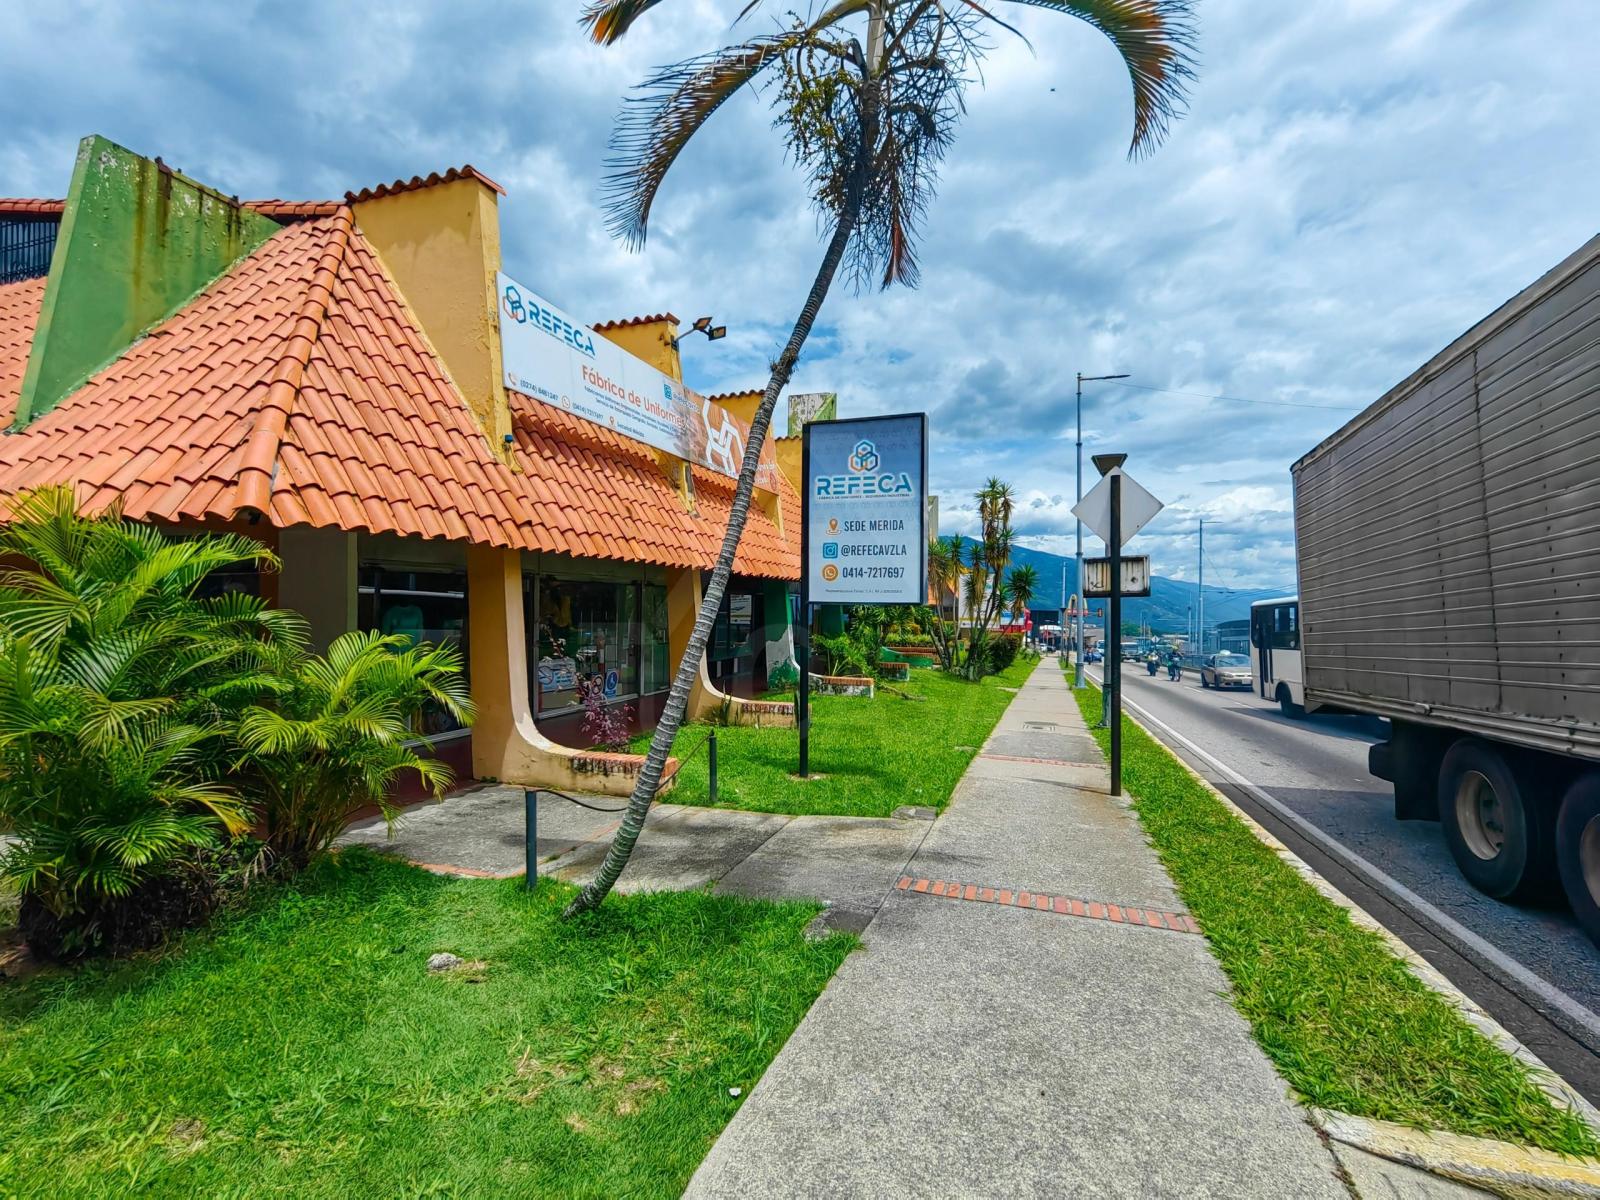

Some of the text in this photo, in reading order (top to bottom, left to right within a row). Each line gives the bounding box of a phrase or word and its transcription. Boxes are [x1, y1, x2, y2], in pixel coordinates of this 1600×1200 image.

[528, 300, 595, 356] REFECA
[582, 365, 625, 400] Fábrica
[628, 390, 641, 407] de
[817, 474, 912, 495] REFECA
[844, 520, 904, 531] SEDE MERIDA
[841, 544, 907, 556] @REFECAVZLA
[842, 567, 905, 578] 0414-7217697
